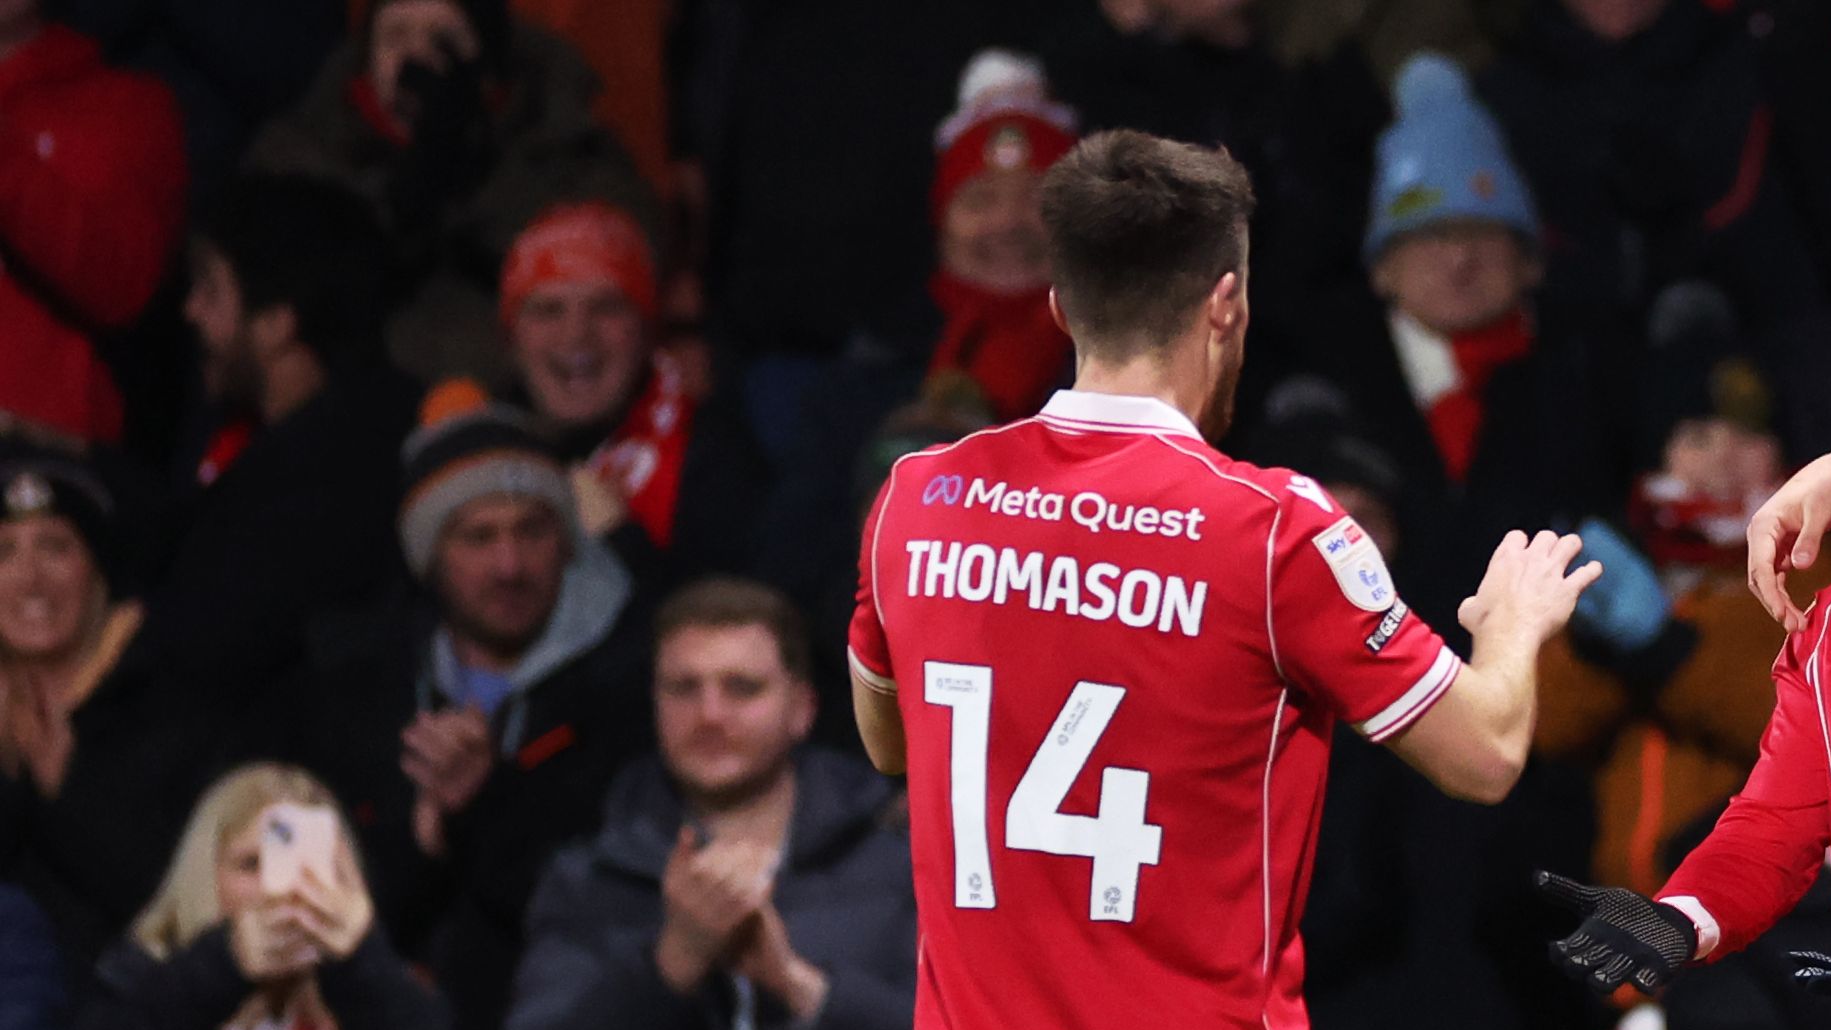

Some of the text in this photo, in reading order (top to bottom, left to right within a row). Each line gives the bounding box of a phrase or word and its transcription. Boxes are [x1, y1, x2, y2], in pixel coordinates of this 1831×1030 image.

[963, 477, 1206, 541] Meta Quest
[905, 539, 1208, 638] THOMASON
[923, 660, 1163, 923] 14
